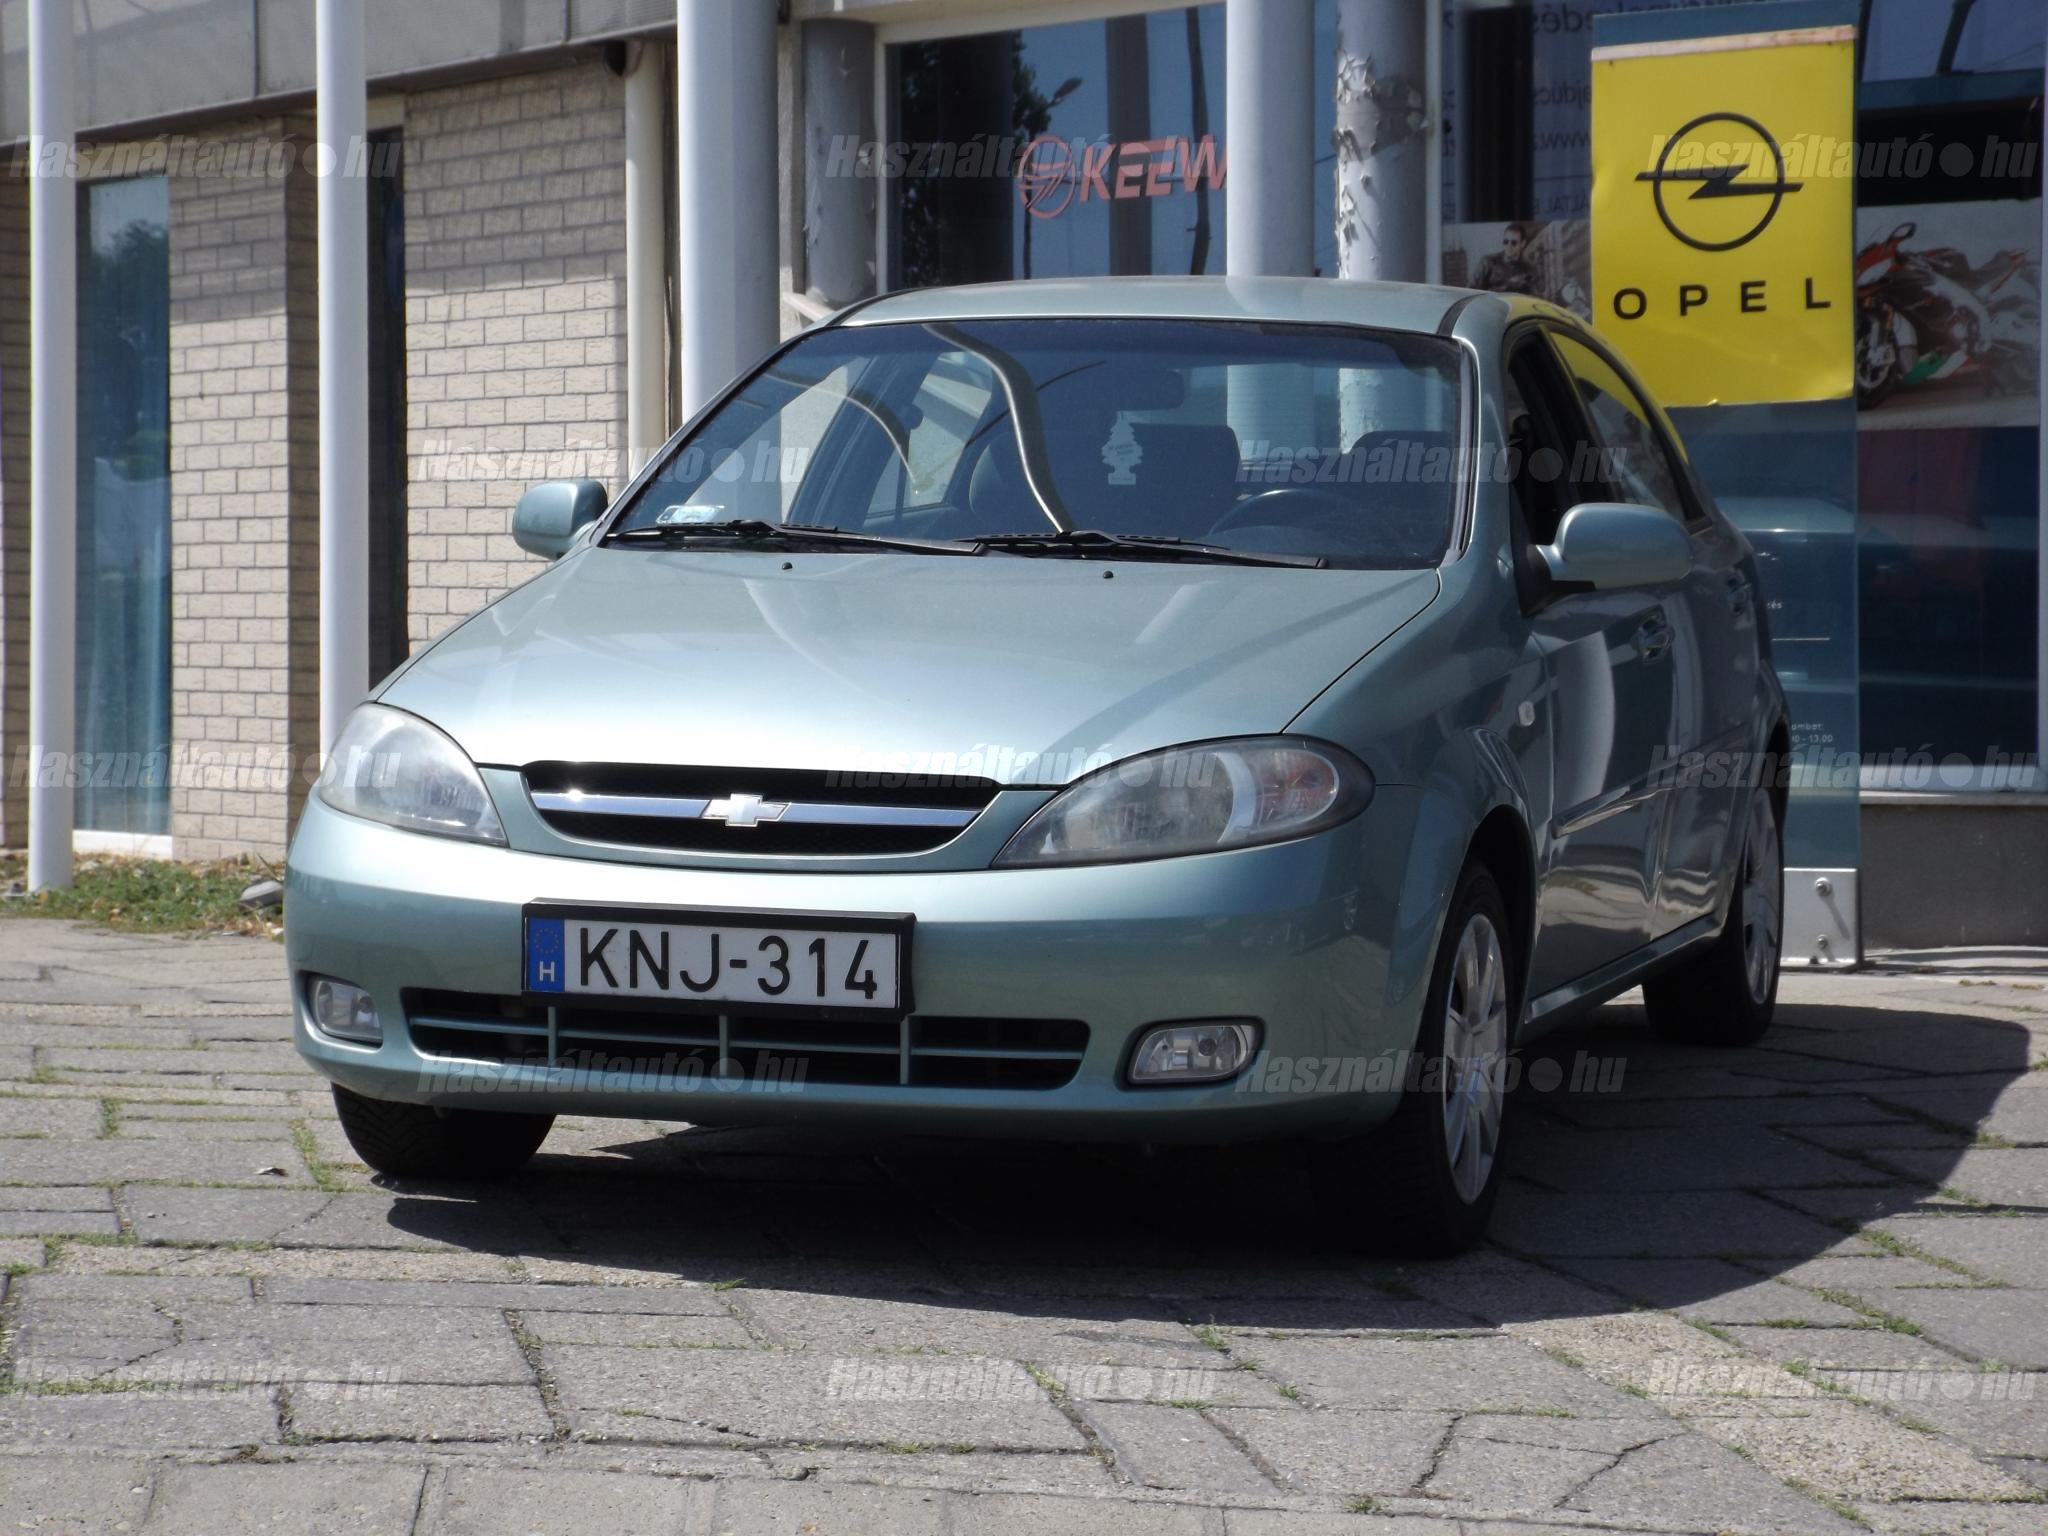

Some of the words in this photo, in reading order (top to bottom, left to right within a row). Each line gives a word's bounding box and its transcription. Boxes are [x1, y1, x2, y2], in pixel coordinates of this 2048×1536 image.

[1612, 277, 1832, 320] OPEL
[539, 960, 556, 983] H
[578, 926, 879, 1000] KNJ-314
